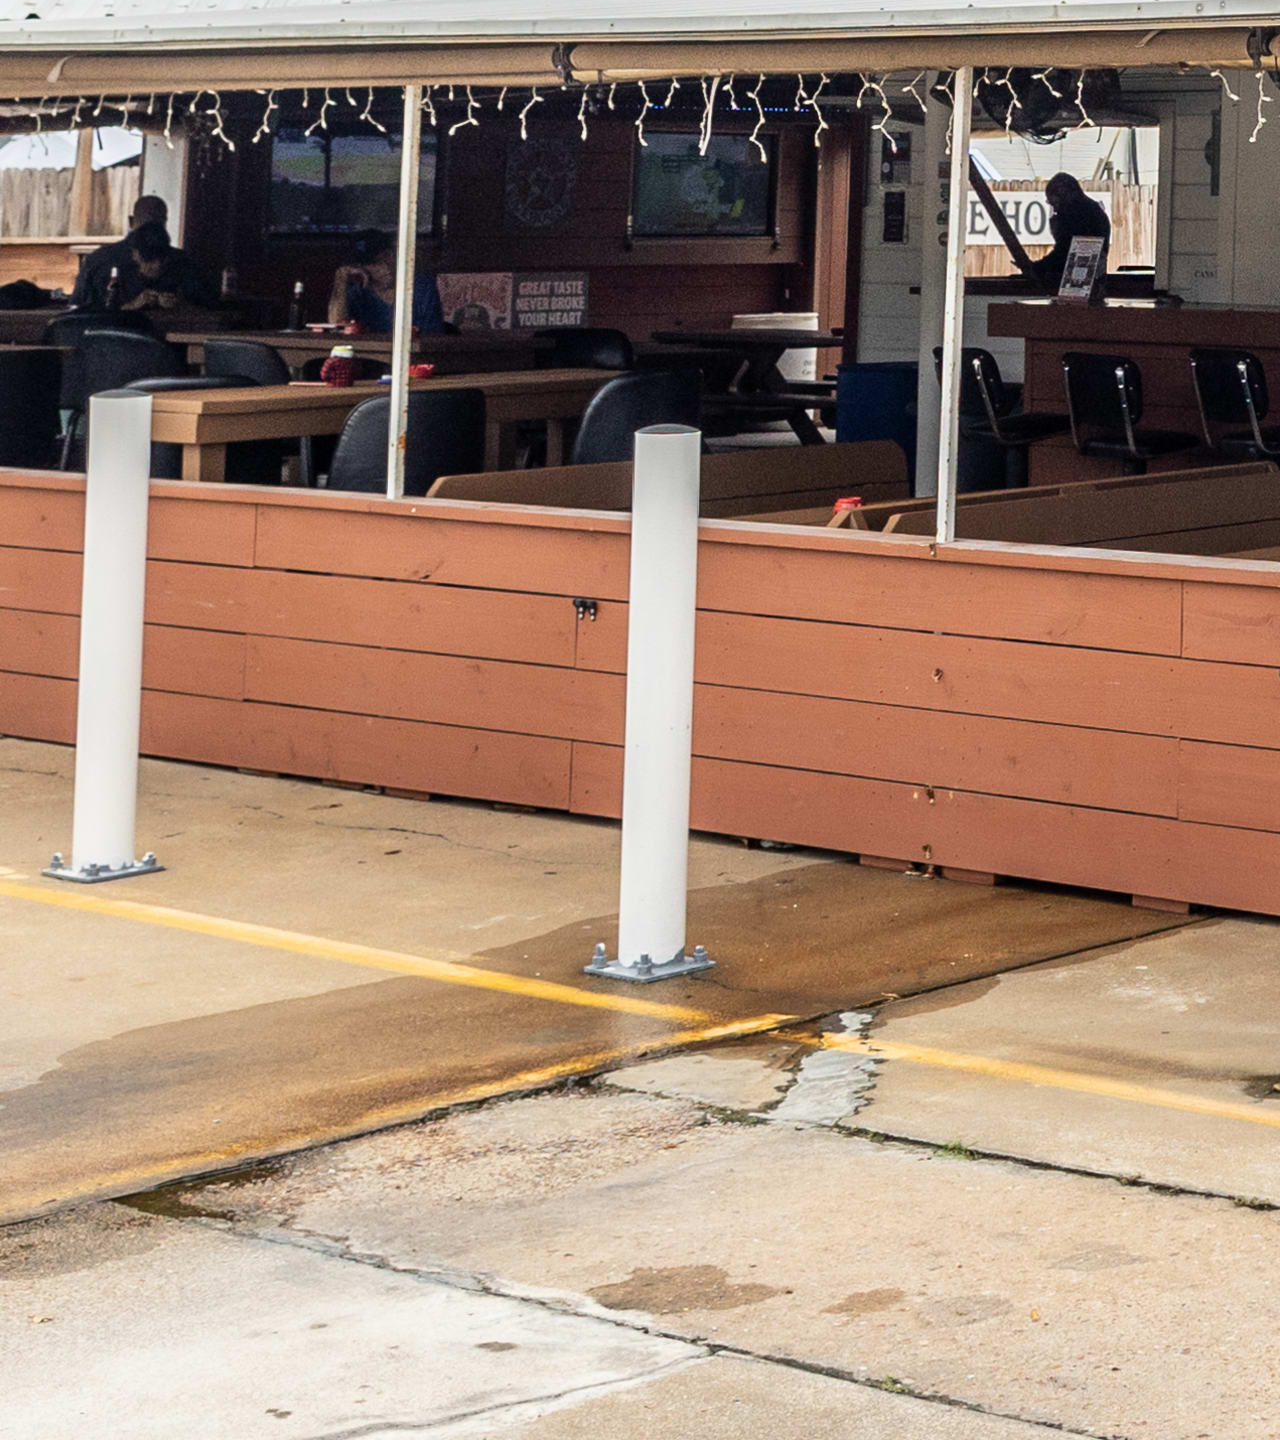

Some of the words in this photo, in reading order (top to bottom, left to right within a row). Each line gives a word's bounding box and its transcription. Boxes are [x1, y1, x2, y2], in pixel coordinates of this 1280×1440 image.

[1000, 200, 1047, 236] HO
[518, 281, 551, 295] GREAT
[553, 281, 584, 295] TASTE
[515, 296, 550, 311] NEVER
[550, 296, 585, 310] BROKE
[518, 312, 547, 326] YOUR
[548, 311, 583, 326] HEART
